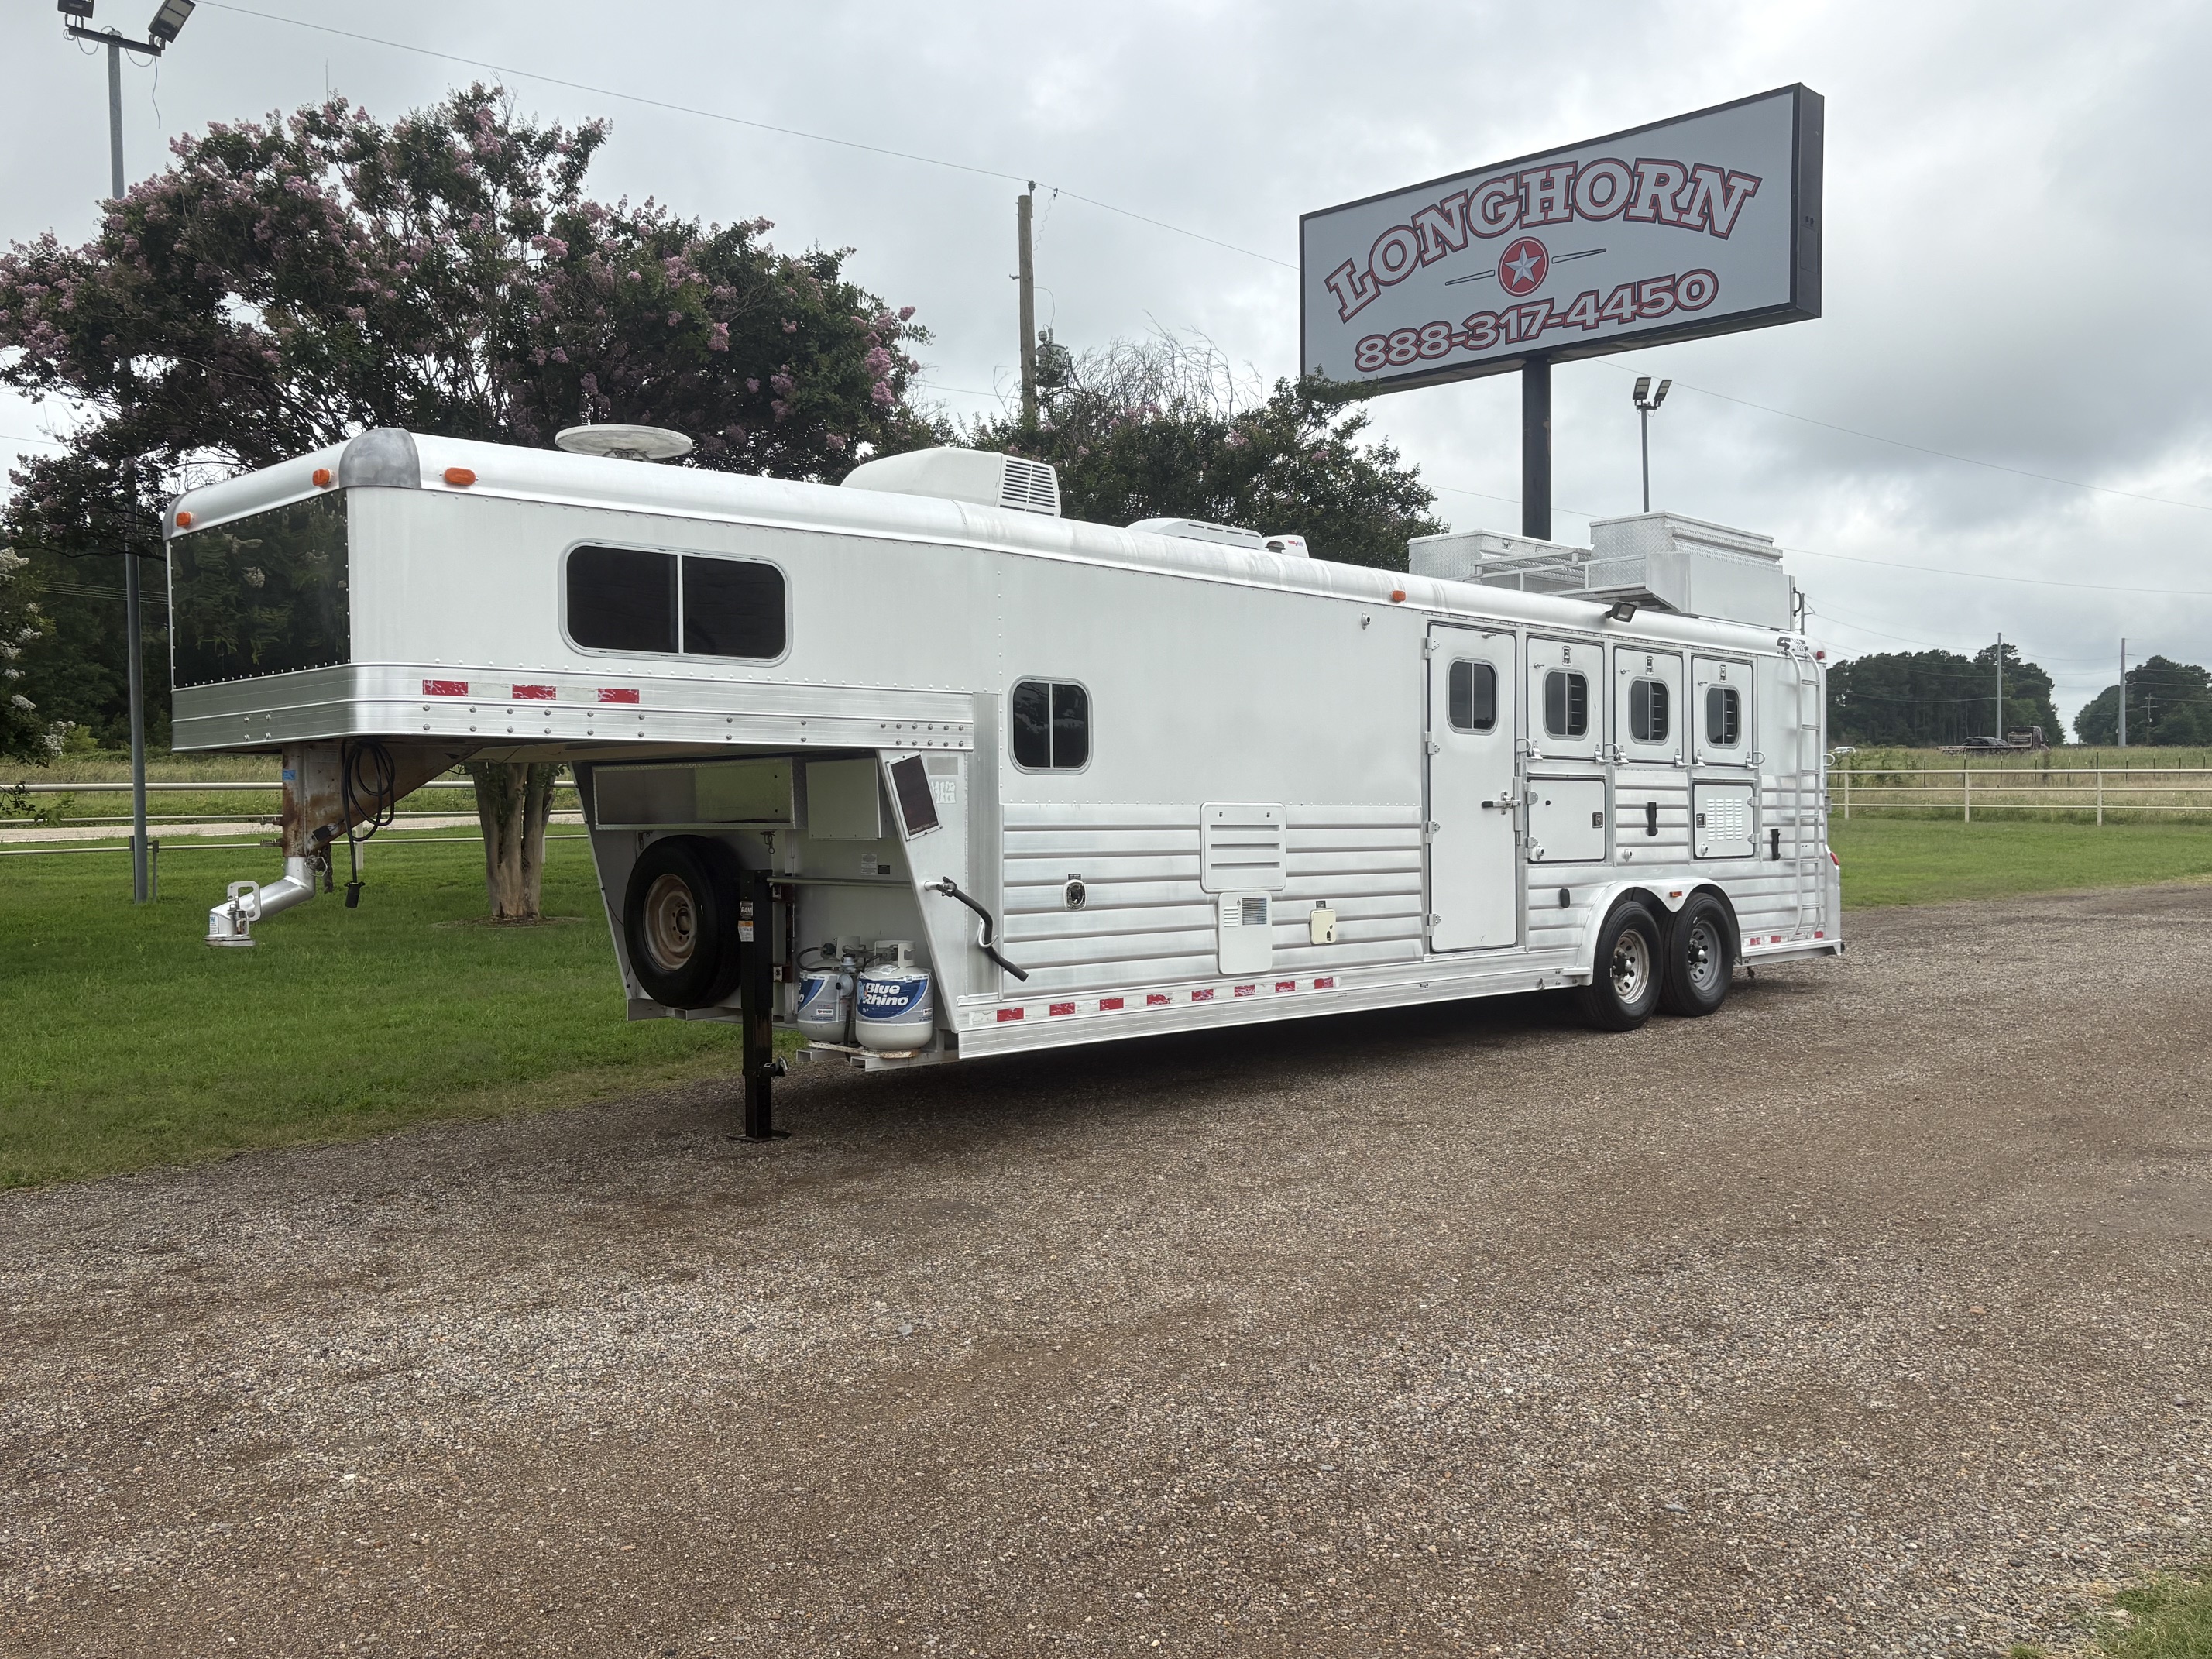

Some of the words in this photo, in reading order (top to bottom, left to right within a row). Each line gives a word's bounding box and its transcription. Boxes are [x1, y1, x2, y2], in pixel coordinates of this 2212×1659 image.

[1325, 157, 1762, 323] LONGHORN
[1355, 268, 1719, 372] 888-317-4450
[862, 994, 909, 1006] Rhino
[865, 982, 901, 994] Blue
